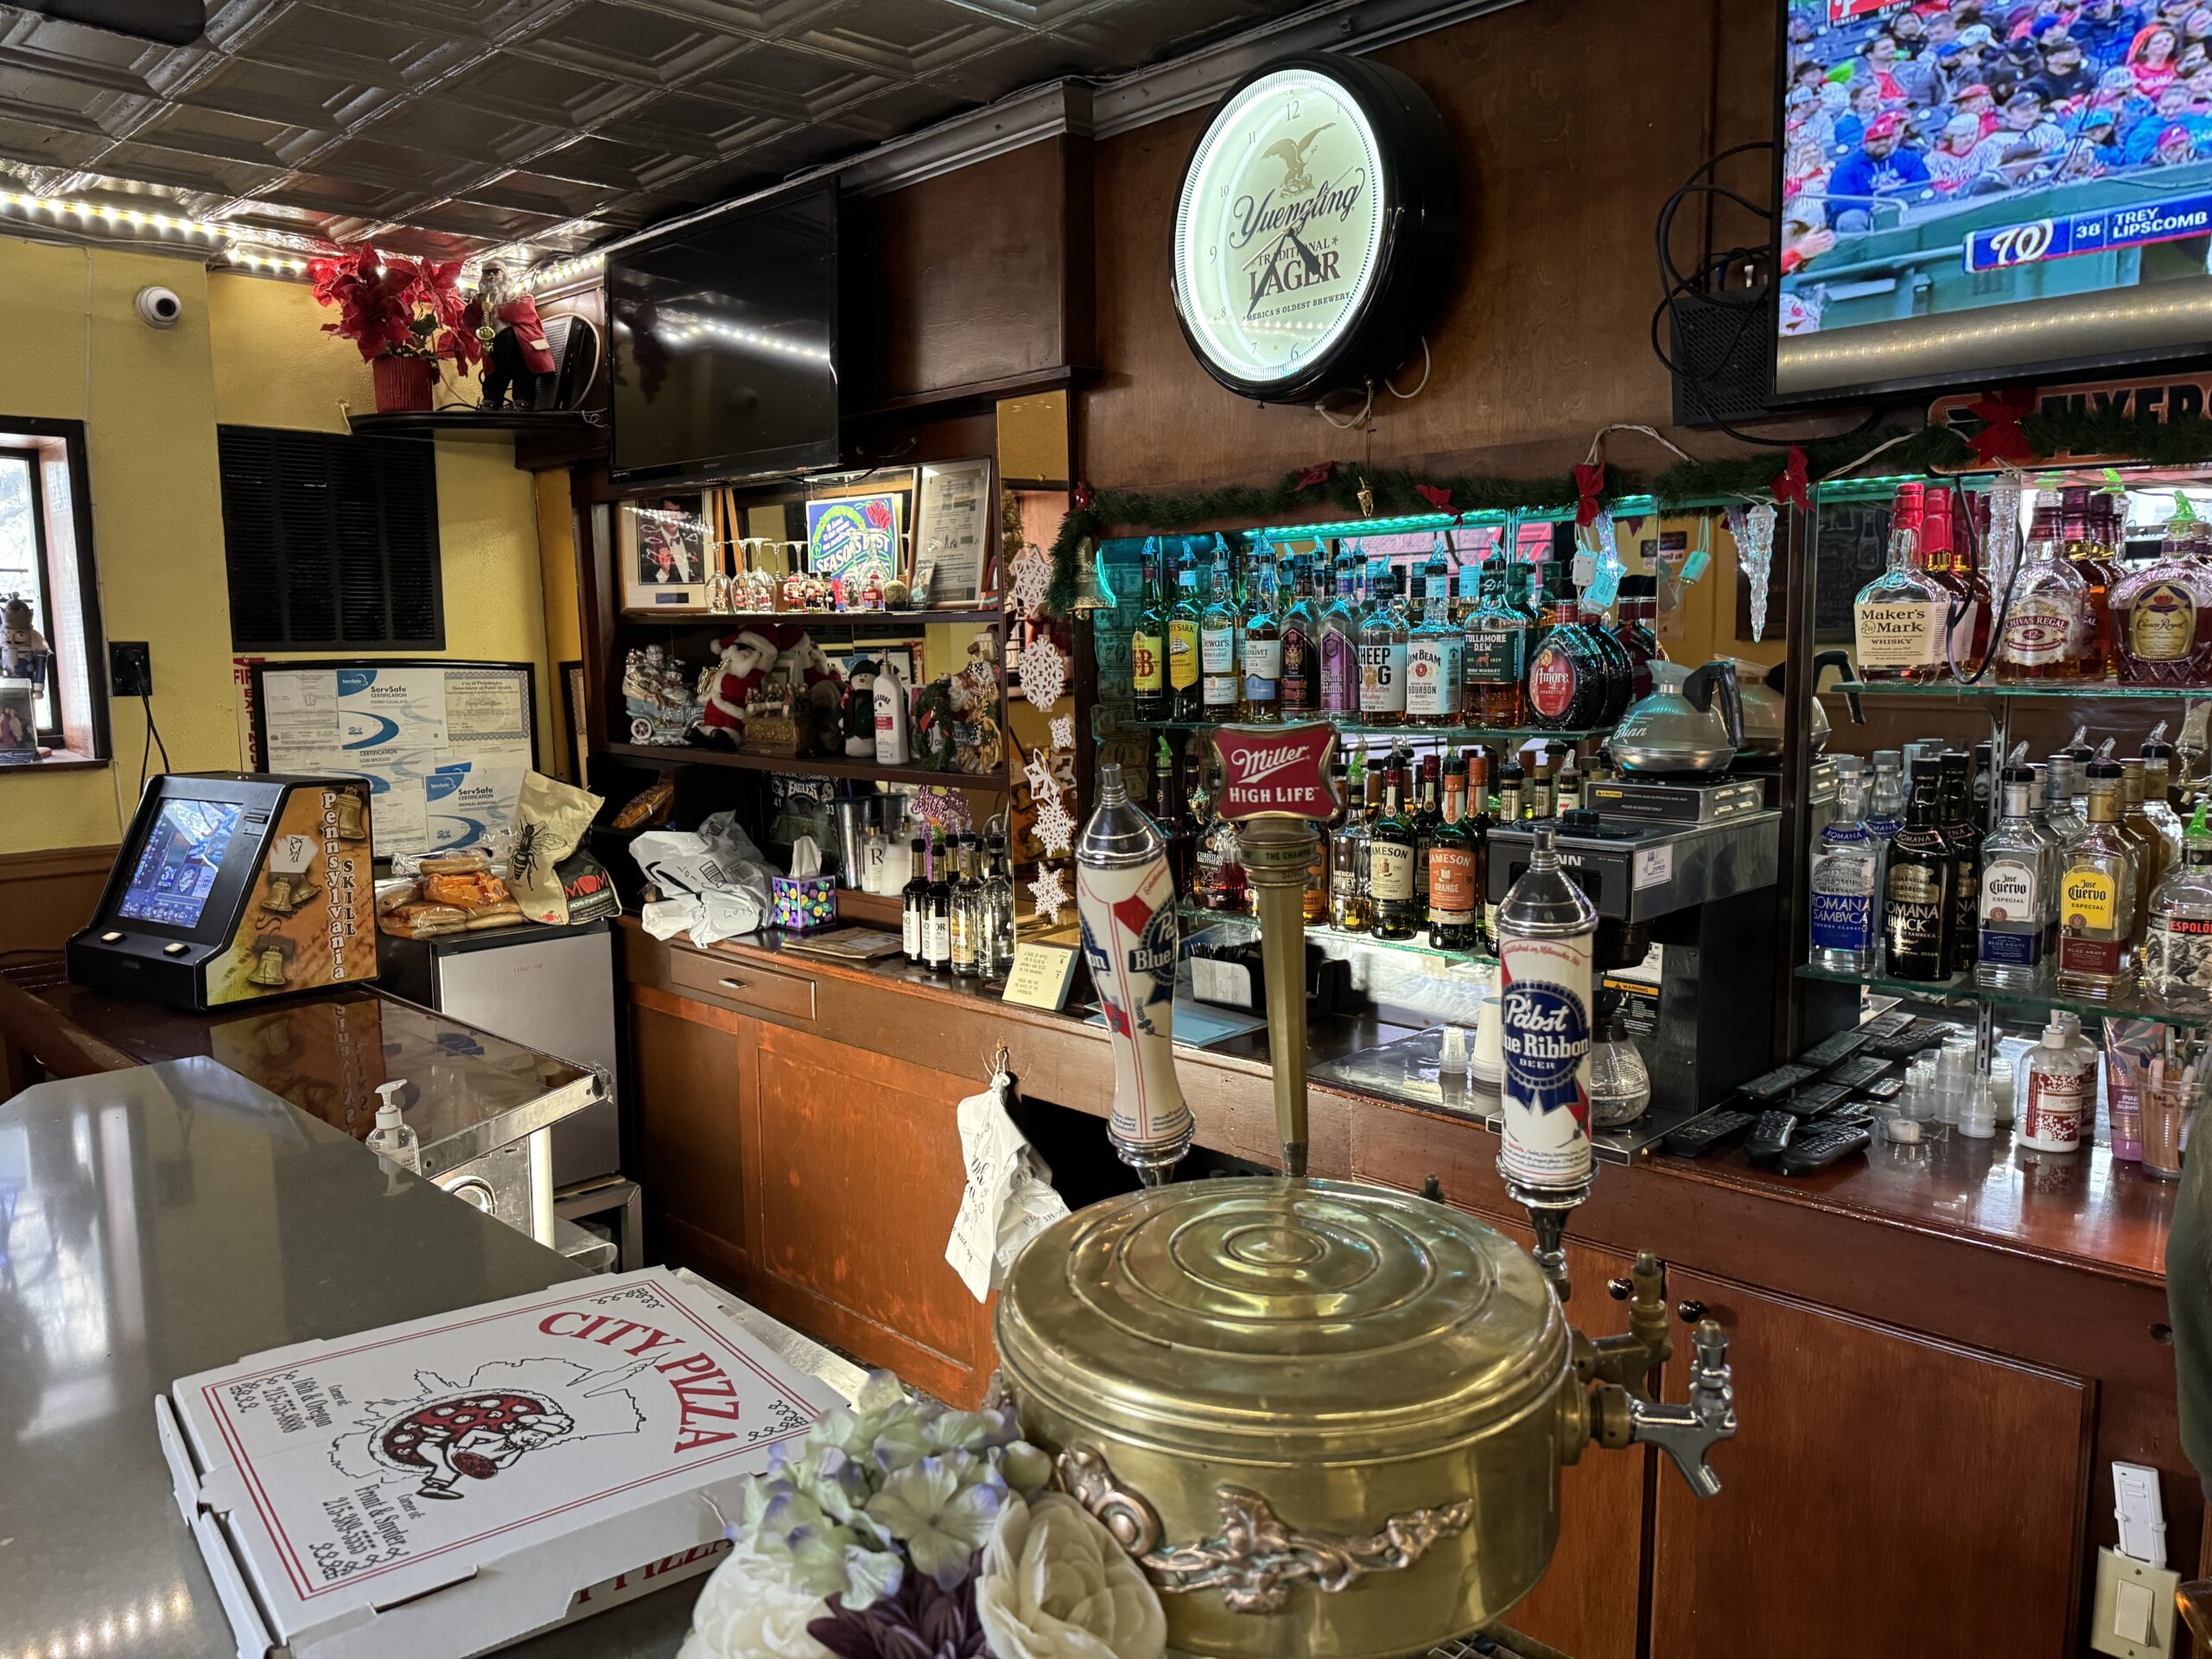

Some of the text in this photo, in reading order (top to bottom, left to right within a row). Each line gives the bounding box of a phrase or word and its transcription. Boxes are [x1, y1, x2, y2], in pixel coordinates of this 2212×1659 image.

[1286, 100, 1300, 123] 12
[1249, 131, 1256, 144] 11
[1220, 184, 1230, 198] 10
[1229, 167, 1366, 249] Yuengling
[2114, 207, 2159, 226] TREY
[2075, 222, 2101, 238] 38
[2113, 212, 2209, 238] LIPSCOMB
[1210, 245, 1217, 264] 9
[1259, 238, 1331, 266] TRDITNAL
[1221, 306, 1227, 318] 8
[1243, 291, 1351, 321] MERICA'S OLDEST BREWERY
[1251, 342, 1257, 354] 7
[1861, 608, 1925, 620] Maker's
[2005, 616, 2066, 629] CHIVAS REGAL
[1177, 624, 1195, 633] SARK
[1877, 622, 1923, 632] Mark
[2137, 617, 2187, 630] Crown Royal
[1465, 633, 1507, 643] TULLAMORE
[1407, 649, 1440, 666] JIM BEAM
[1534, 668, 1569, 686] Amore
[1231, 745, 1310, 778] Miller
[787, 780, 818, 801] EAGLES
[1229, 786, 1315, 803] HIGH LIFE
[825, 804, 835, 815] 33
[1826, 829, 1863, 839] ROMANA
[1370, 847, 1408, 860] AMESON
[321, 791, 346, 981] Pennsylvania
[1333, 876, 1356, 887] HONEY
[1989, 879, 2027, 895] Cuervo
[2002, 874, 2018, 884] Jose
[2080, 880, 2097, 889] Jose
[1434, 883, 1459, 893] ORANGE
[2068, 884, 2107, 901] Cuervo
[341, 859, 356, 937] SKILL
[1885, 902, 1939, 919] OMANA
[1134, 949, 1171, 970] Blue
[1622, 983, 1649, 993] WARNING
[1505, 994, 1569, 1032] Pabst
[1523, 1033, 1590, 1059] Ribbon
[1519, 1058, 1555, 1070] BEER
[537, 1311, 686, 1357] CITY
[292, 1377, 319, 1395] 16th
[327, 1384, 345, 1402] Corner
[262, 1385, 307, 1433] 215-755-8888
[654, 1351, 741, 1453] PIZZA
[304, 1399, 333, 1428] Oregon
[397, 1493, 421, 1514] Corner
[354, 1483, 387, 1510] Front
[372, 1514, 410, 1548] Snyder
[322, 1496, 377, 1554] 215-389-5555
